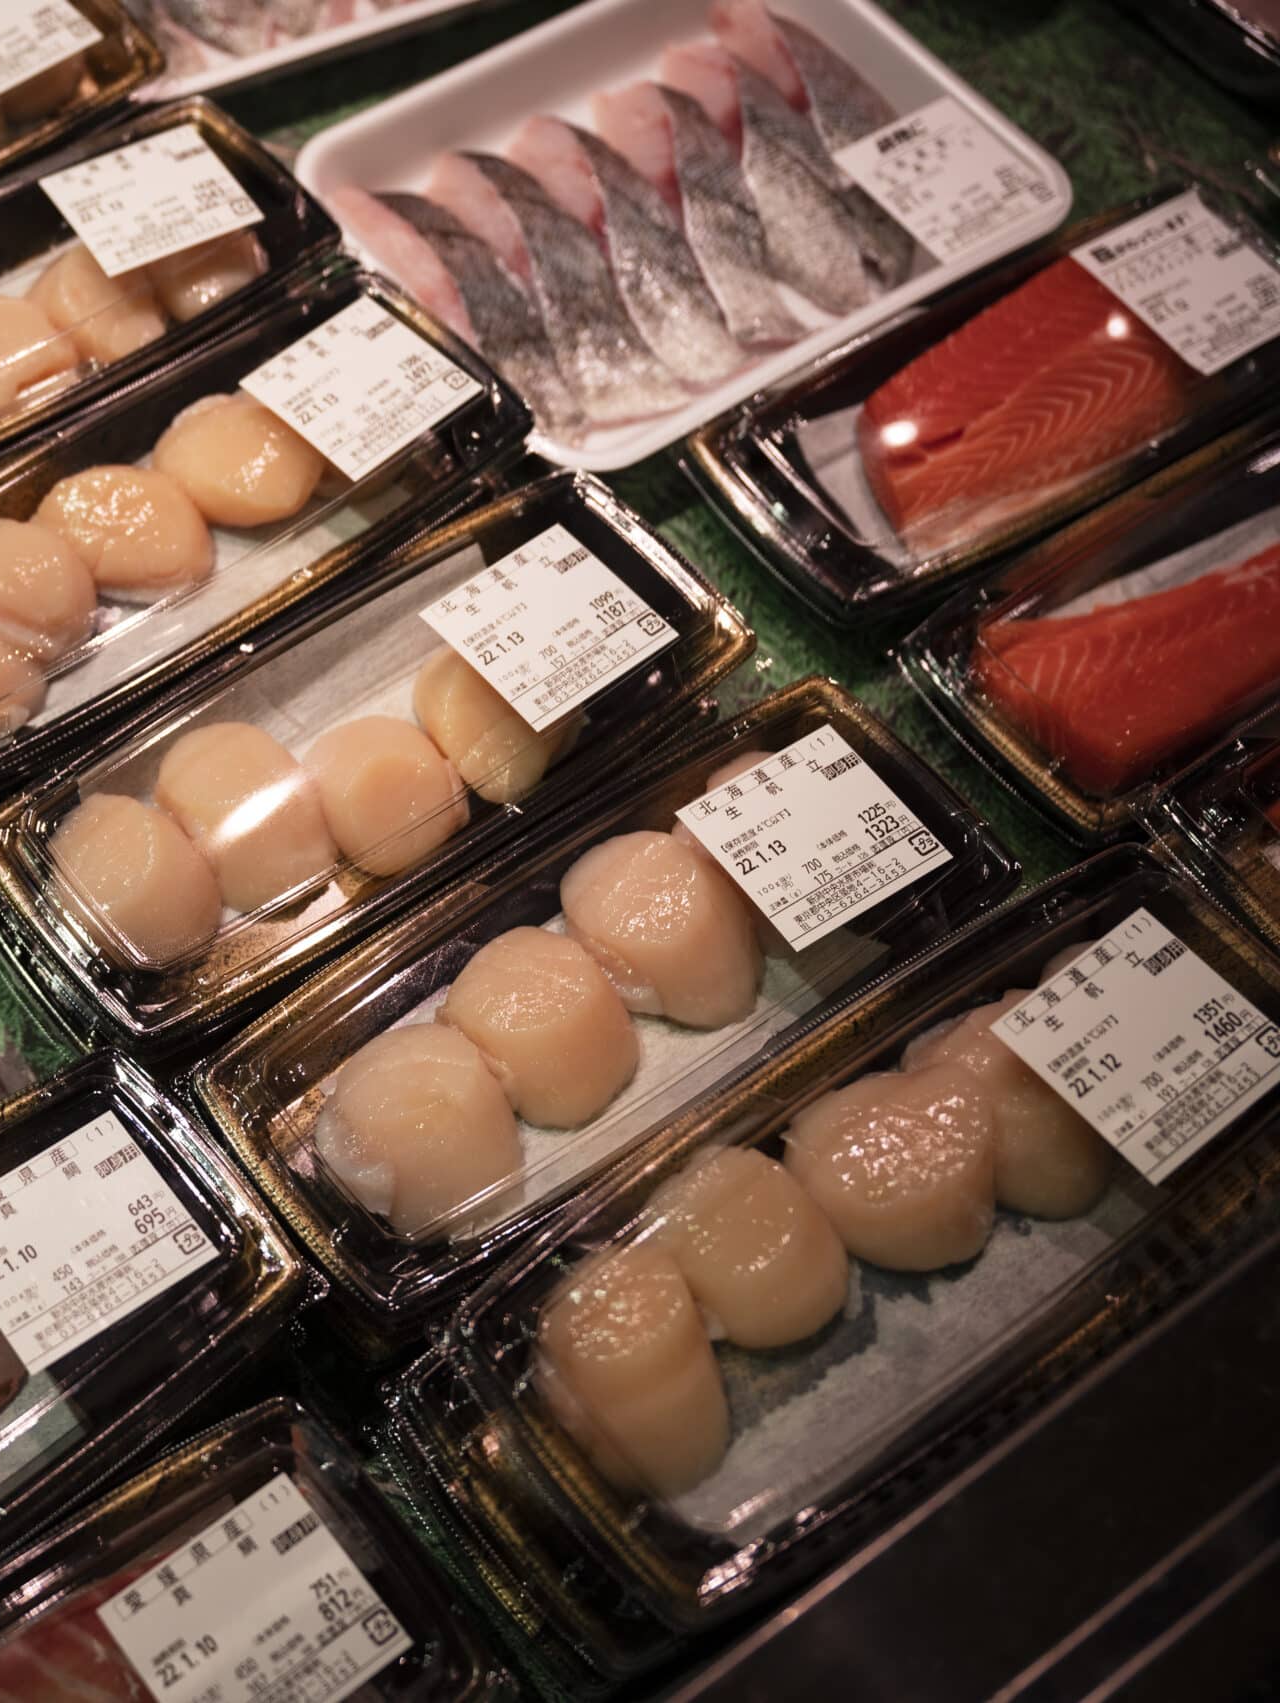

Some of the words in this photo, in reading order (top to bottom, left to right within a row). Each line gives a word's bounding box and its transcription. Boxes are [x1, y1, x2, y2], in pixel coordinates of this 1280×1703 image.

[441, 552, 529, 613] 北海道産
[466, 556, 554, 616] 生帆立
[539, 645, 557, 659] 700
[550, 654, 570, 670] 157
[699, 754, 797, 815] 北海道産
[725, 760, 823, 820] 生帆立
[802, 858, 822, 874] 700
[814, 869, 834, 886] 175
[817, 865, 907, 921] 03-6264-3453
[1014, 944, 1114, 1027] 北海道産
[1044, 951, 1144, 1032] 生帆立
[1141, 1072, 1163, 1090] 700
[1157, 1085, 1179, 1104] 193
[53, 1264, 73, 1281] 450
[62, 1277, 84, 1295] 143
[123, 1517, 244, 1614] 愛媛県産
